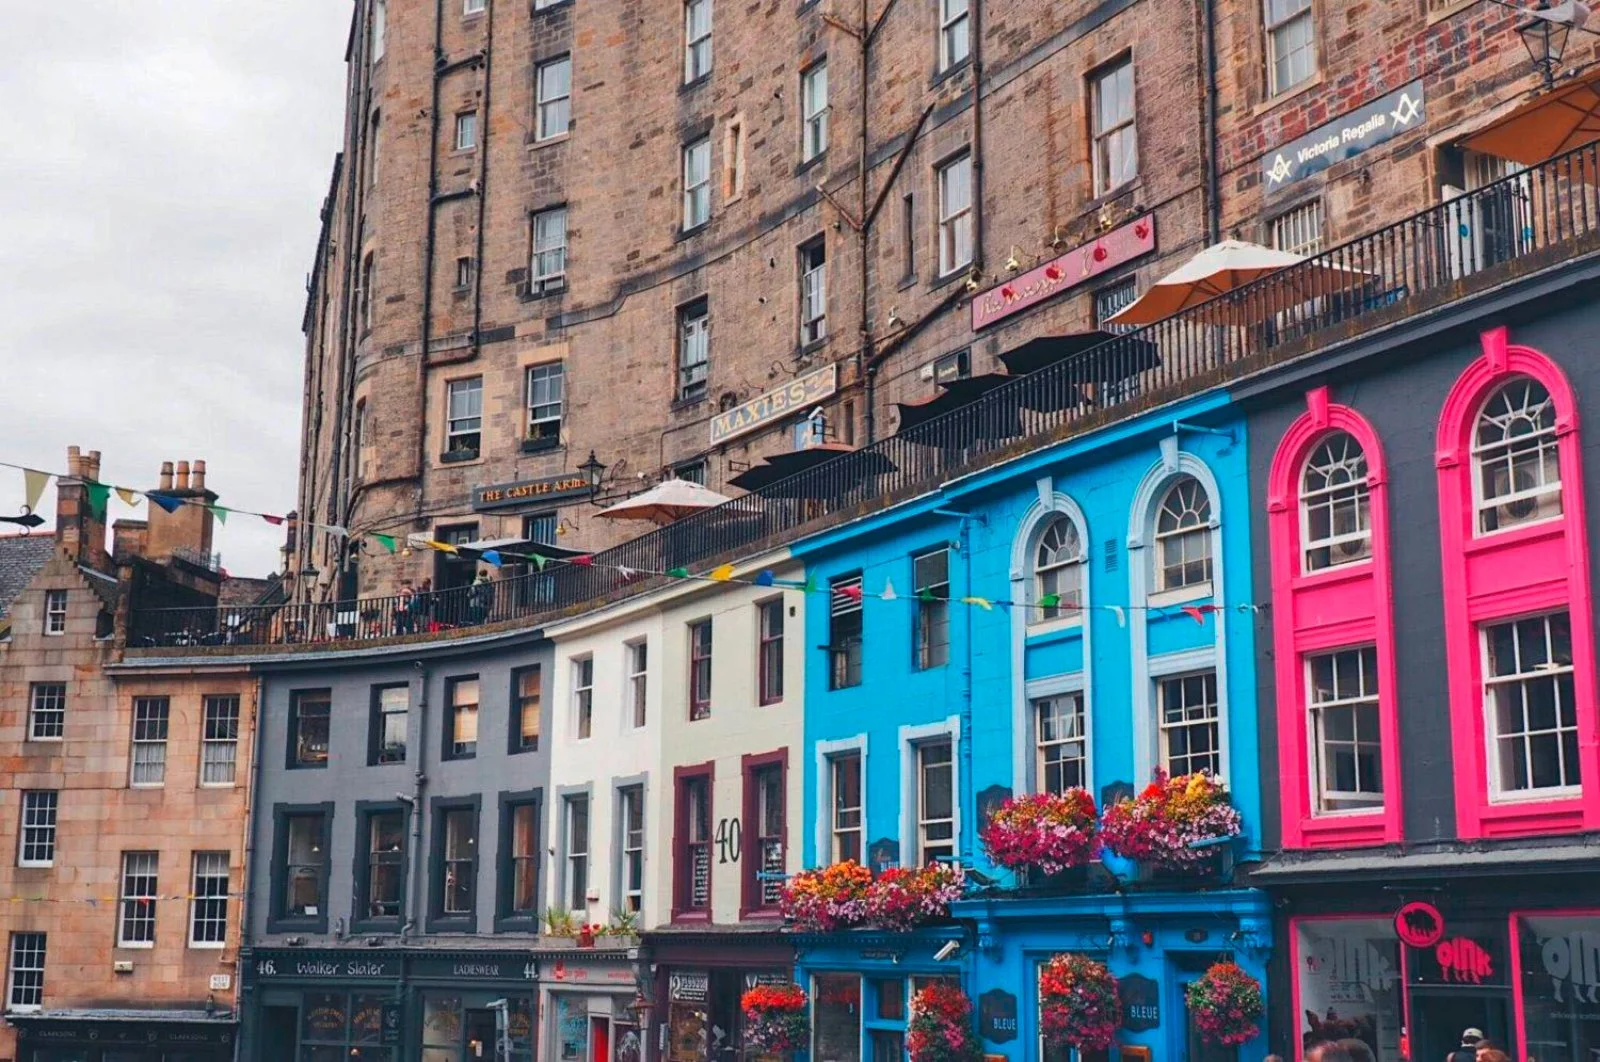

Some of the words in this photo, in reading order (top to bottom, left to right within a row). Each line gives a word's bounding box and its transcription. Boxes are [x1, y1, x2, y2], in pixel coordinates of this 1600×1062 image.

[1297, 135, 1340, 164] Victoria
[1341, 113, 1386, 142] Regalia
[479, 490, 502, 502] THE
[506, 482, 550, 498] CASTLE
[553, 478, 589, 492] ARMS
[714, 817, 741, 865] 40
[256, 960, 277, 975] 46.
[296, 961, 340, 975] Walker
[347, 961, 385, 975] Slater
[453, 964, 499, 976] LADIESWEAR
[1131, 1005, 1158, 1020] BLEUE
[993, 1017, 1016, 1030] BLEUE
